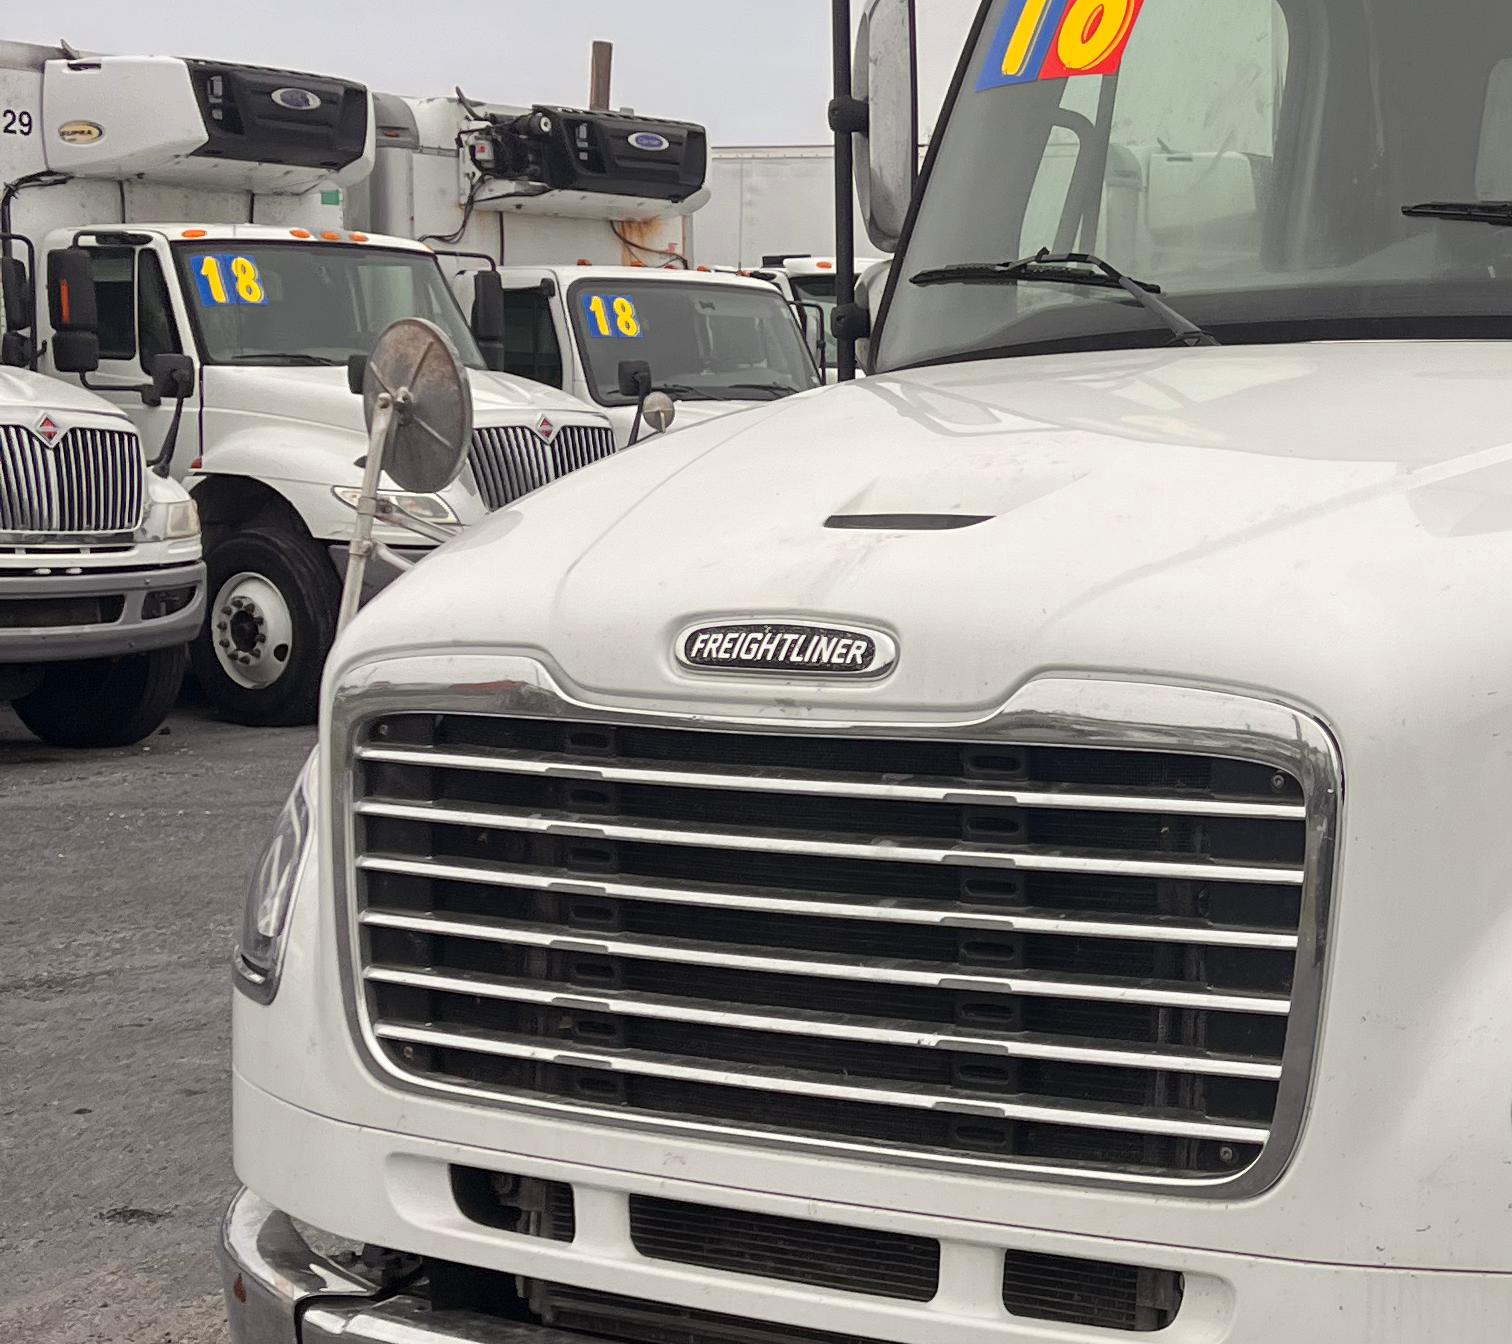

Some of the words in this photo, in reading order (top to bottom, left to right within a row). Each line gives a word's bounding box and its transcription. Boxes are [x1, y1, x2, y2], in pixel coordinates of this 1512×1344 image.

[3, 109, 33, 136] 29
[201, 256, 264, 304] 18
[589, 296, 641, 337] 18
[690, 632, 868, 665] FREIGHTLINER
